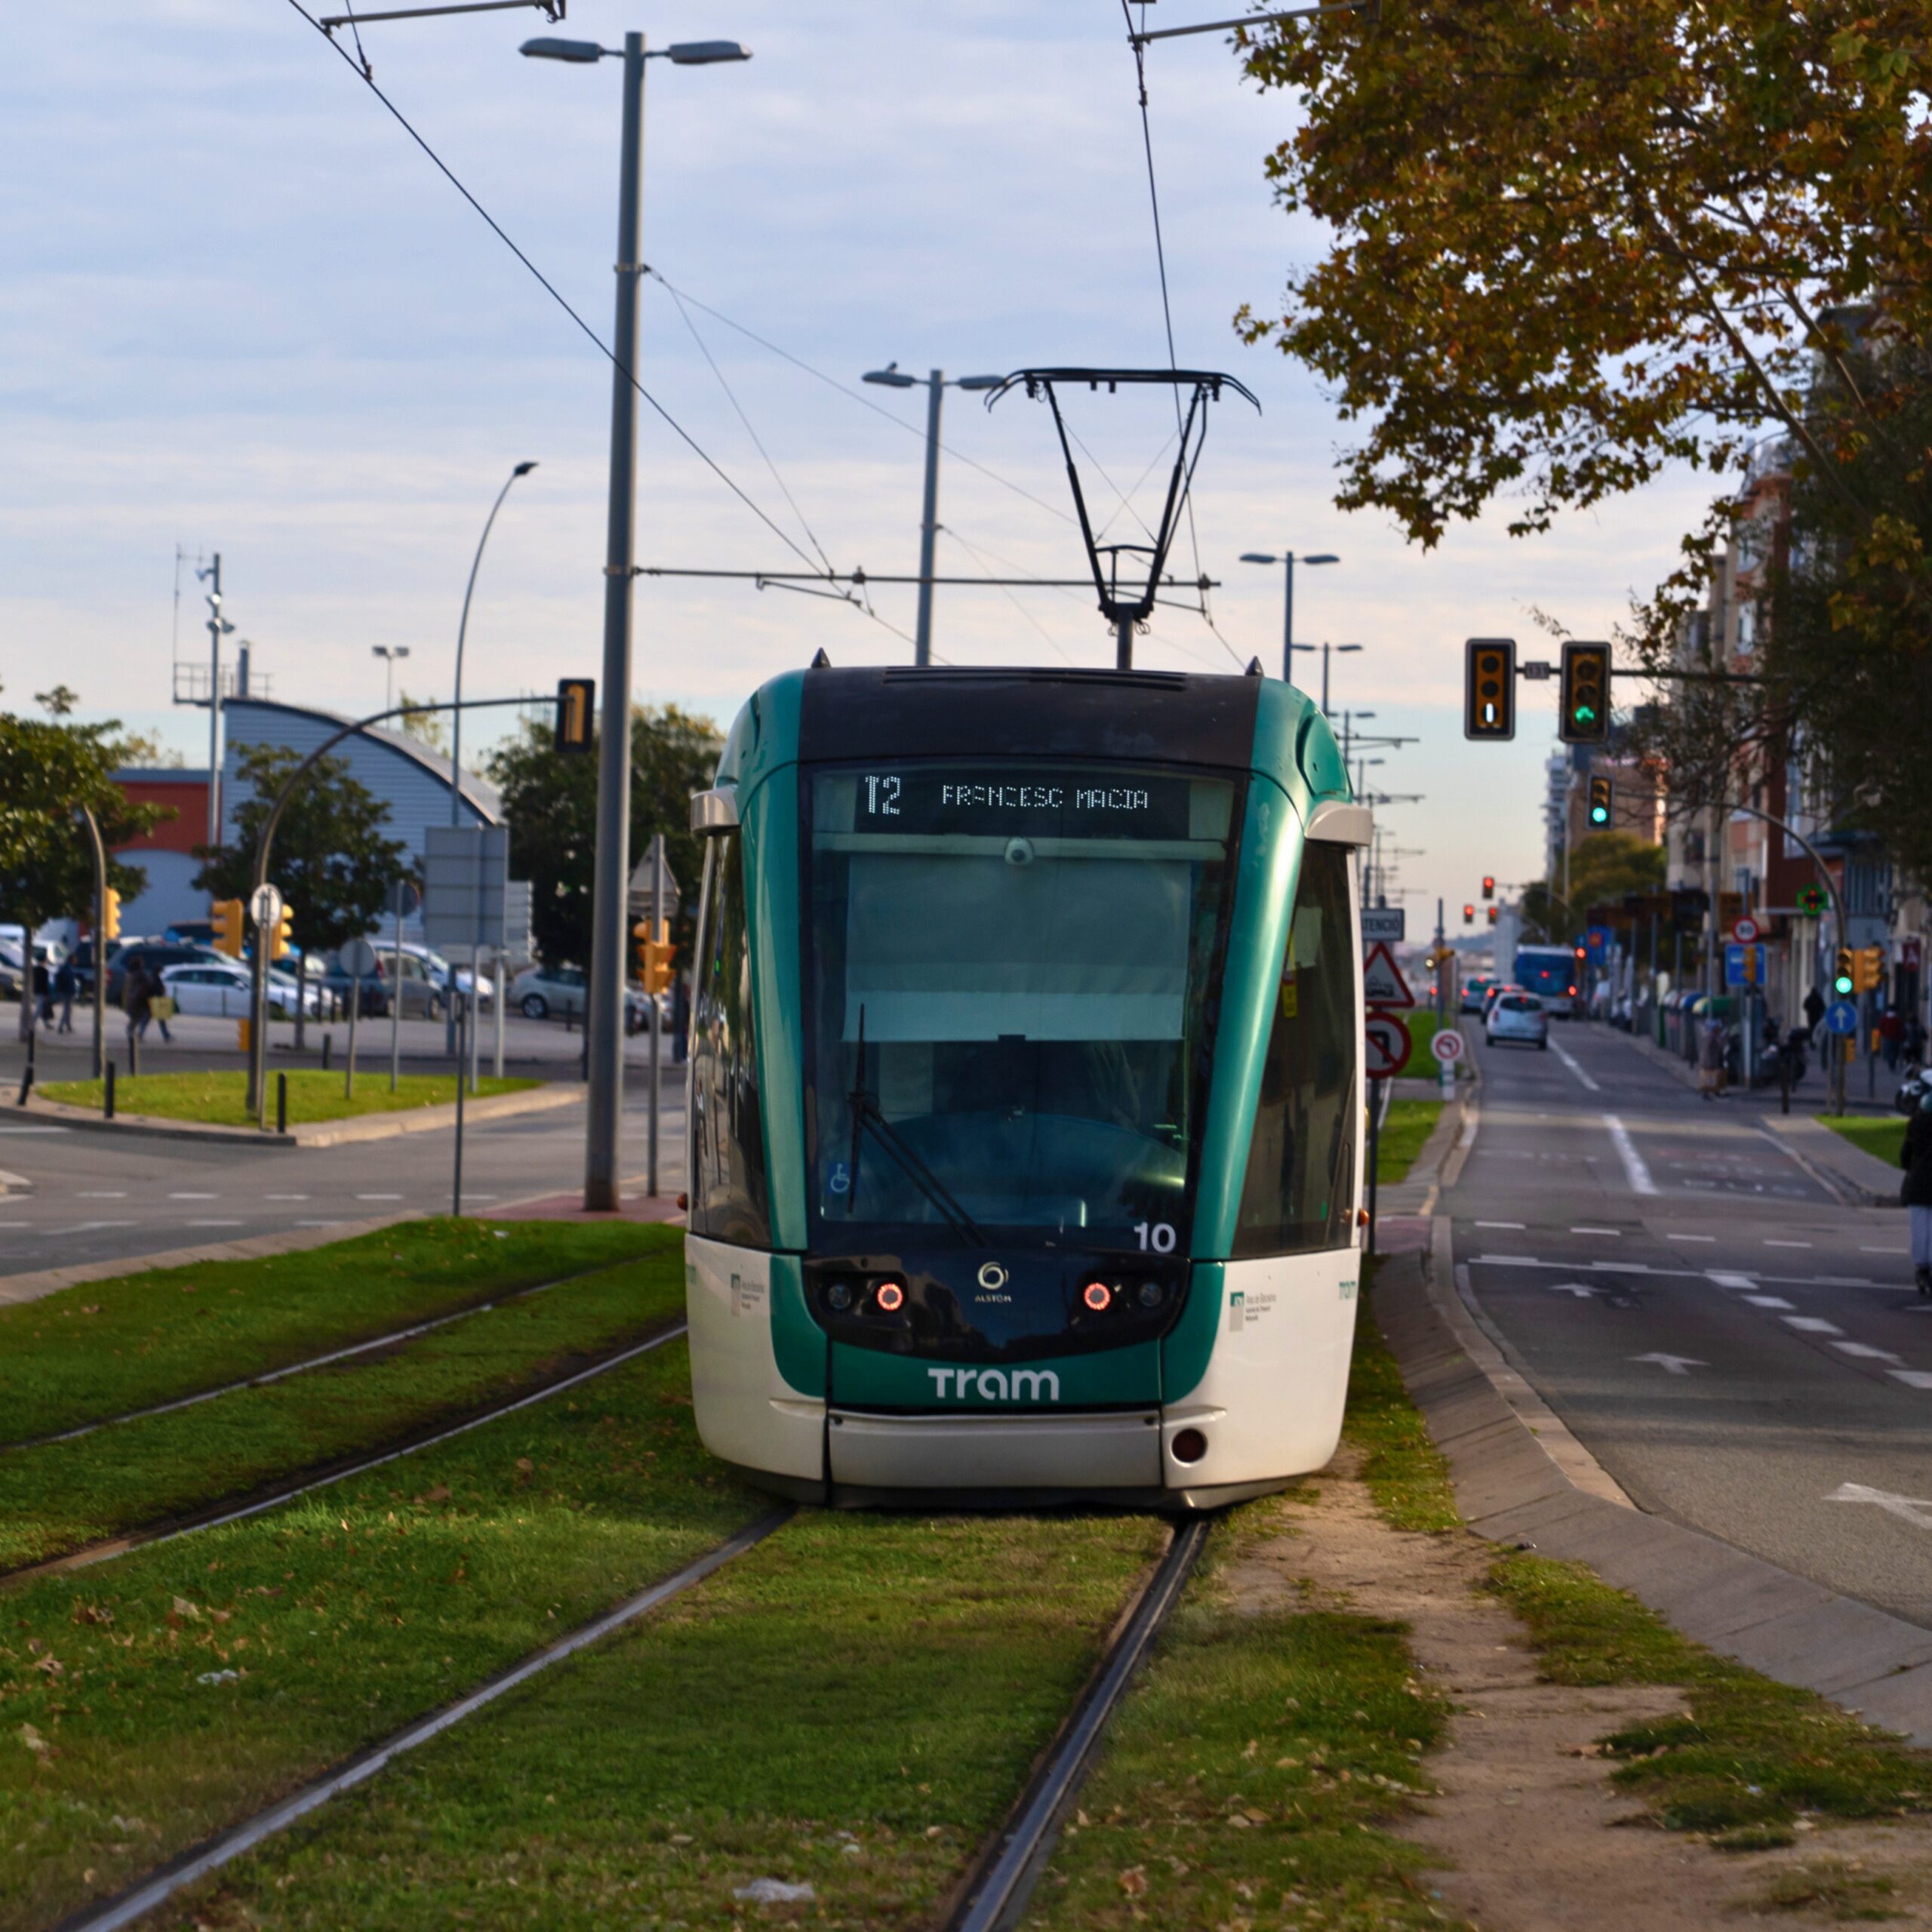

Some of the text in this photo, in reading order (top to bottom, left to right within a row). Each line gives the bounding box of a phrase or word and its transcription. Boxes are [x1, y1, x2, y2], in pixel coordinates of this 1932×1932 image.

[865, 775, 1147, 814] T2 FRANCESC MACIA
[1134, 1221, 1177, 1254] 10
